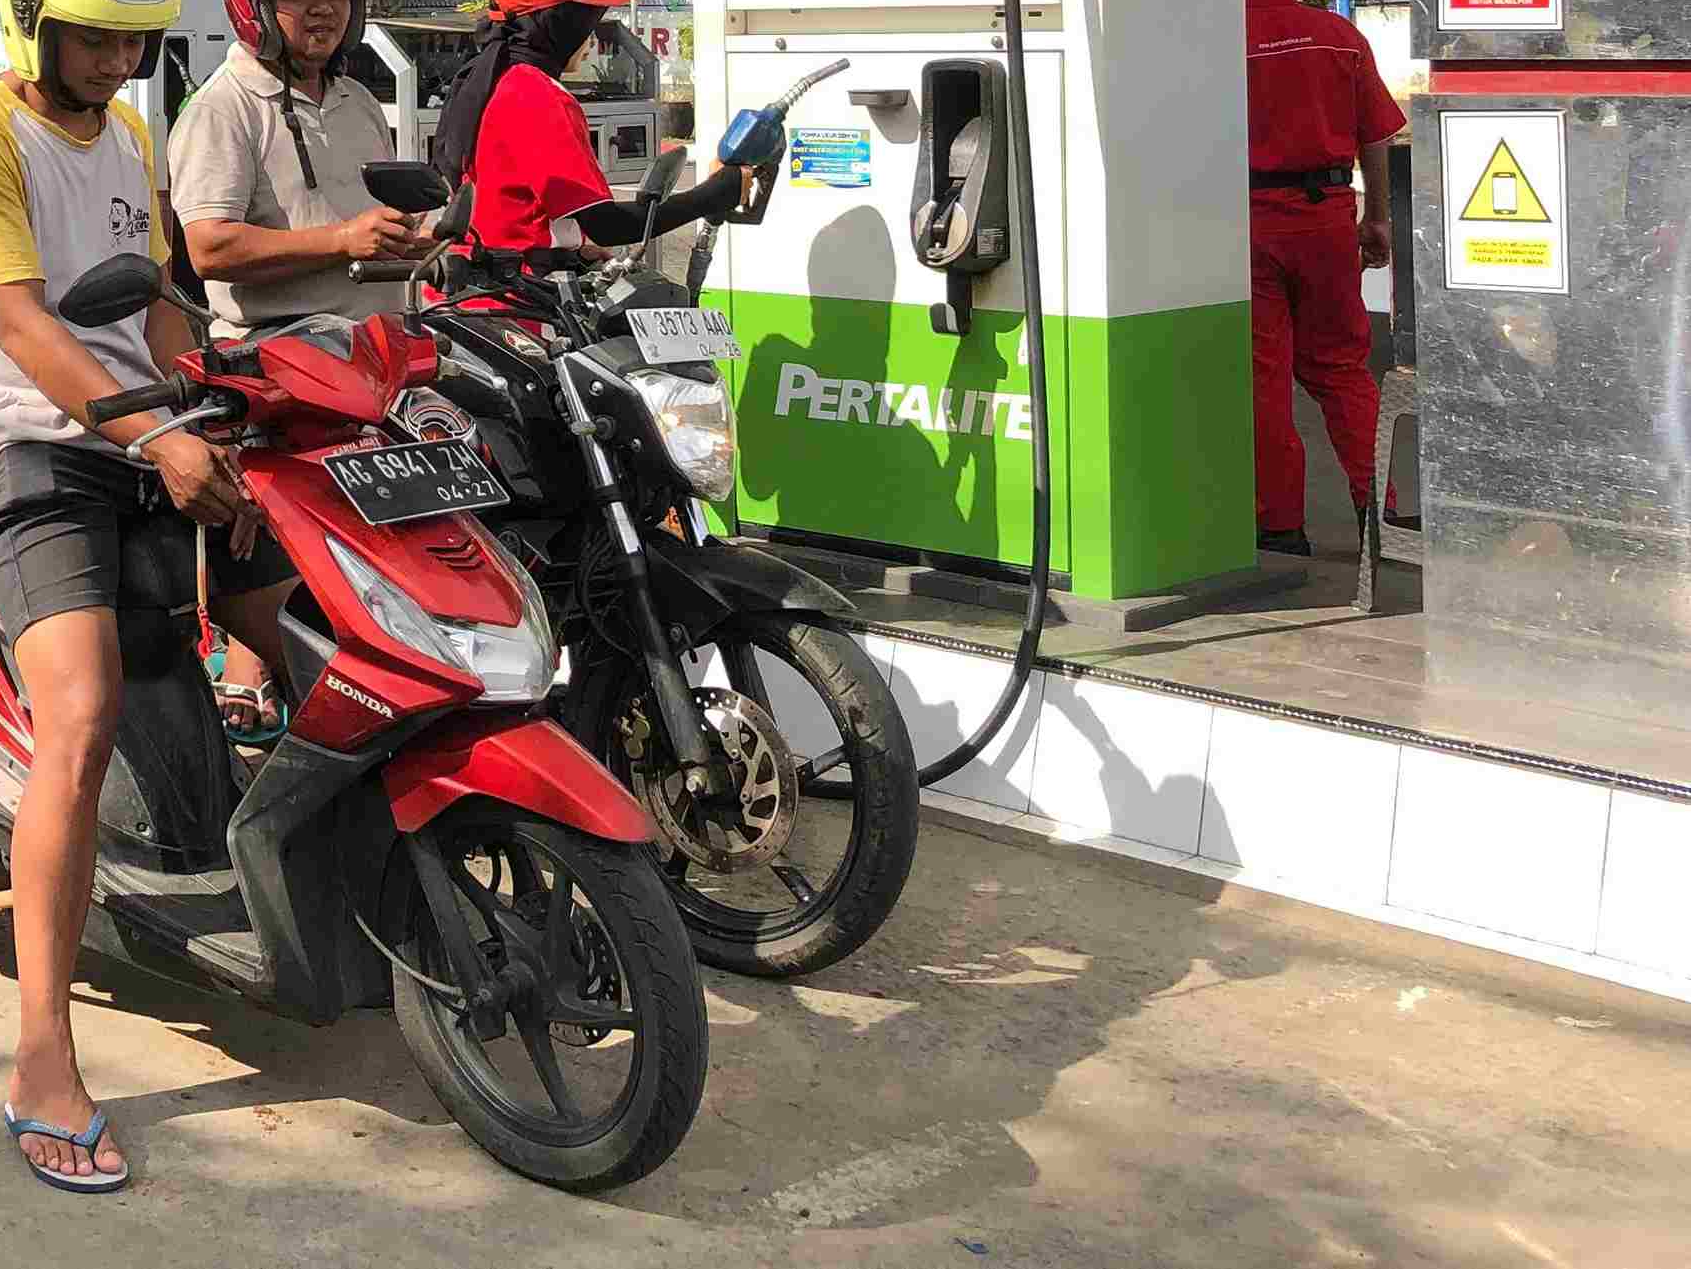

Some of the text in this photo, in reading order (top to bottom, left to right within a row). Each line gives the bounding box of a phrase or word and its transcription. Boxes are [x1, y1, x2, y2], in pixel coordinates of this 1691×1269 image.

[630, 313, 648, 338] N
[654, 312, 698, 336] 3573
[773, 362, 1032, 441] PERTALITE
[336, 444, 478, 488] AG 6941 ZM
[326, 674, 394, 719] HONDA
